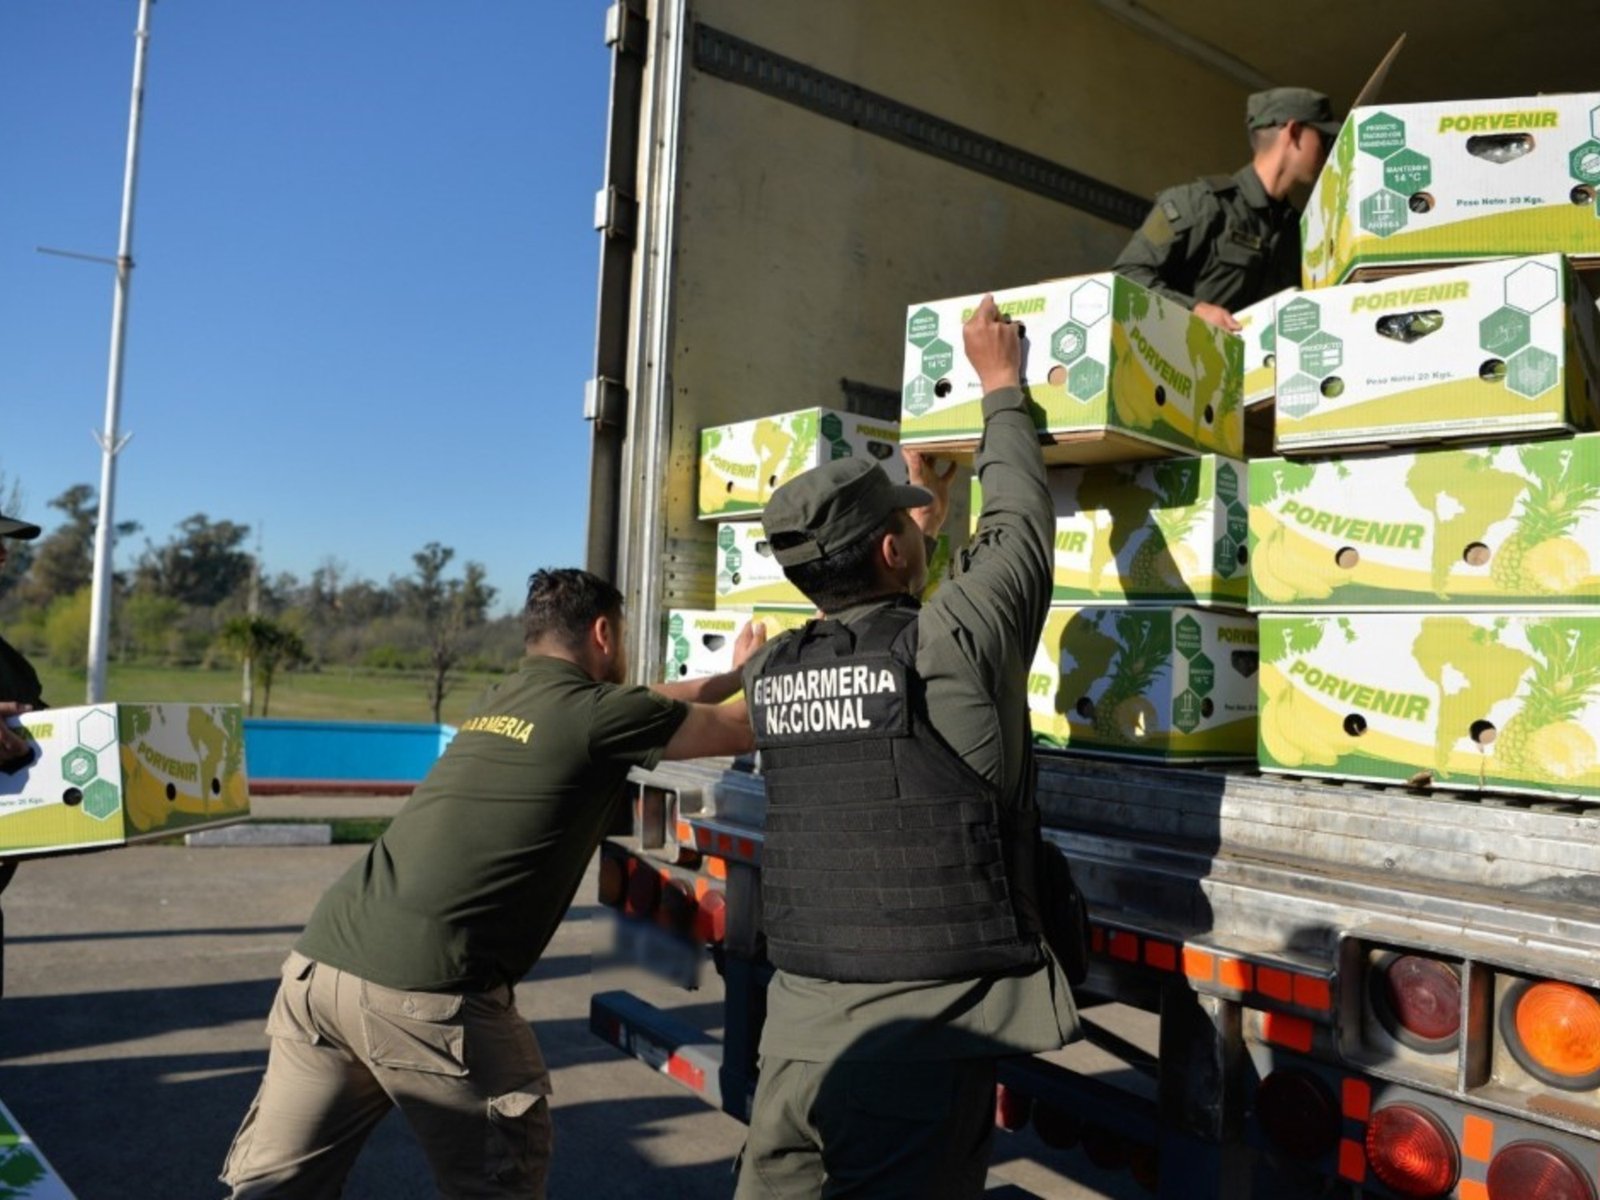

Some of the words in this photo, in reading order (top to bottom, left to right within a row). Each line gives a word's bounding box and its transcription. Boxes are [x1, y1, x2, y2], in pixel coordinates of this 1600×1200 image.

[1438, 111, 1558, 134] PORVENIR
[1394, 173, 1407, 182] 14
[1351, 281, 1469, 314] PORVENIR
[1130, 326, 1193, 399] PORVENIR
[709, 453, 758, 479] PORVENIR
[1279, 499, 1426, 550] PORVENIR
[754, 665, 896, 705] GENDARMERIA
[1287, 659, 1432, 723] PORVENIR
[766, 697, 871, 735] NACIONAL
[136, 741, 199, 782] PORVENIR
